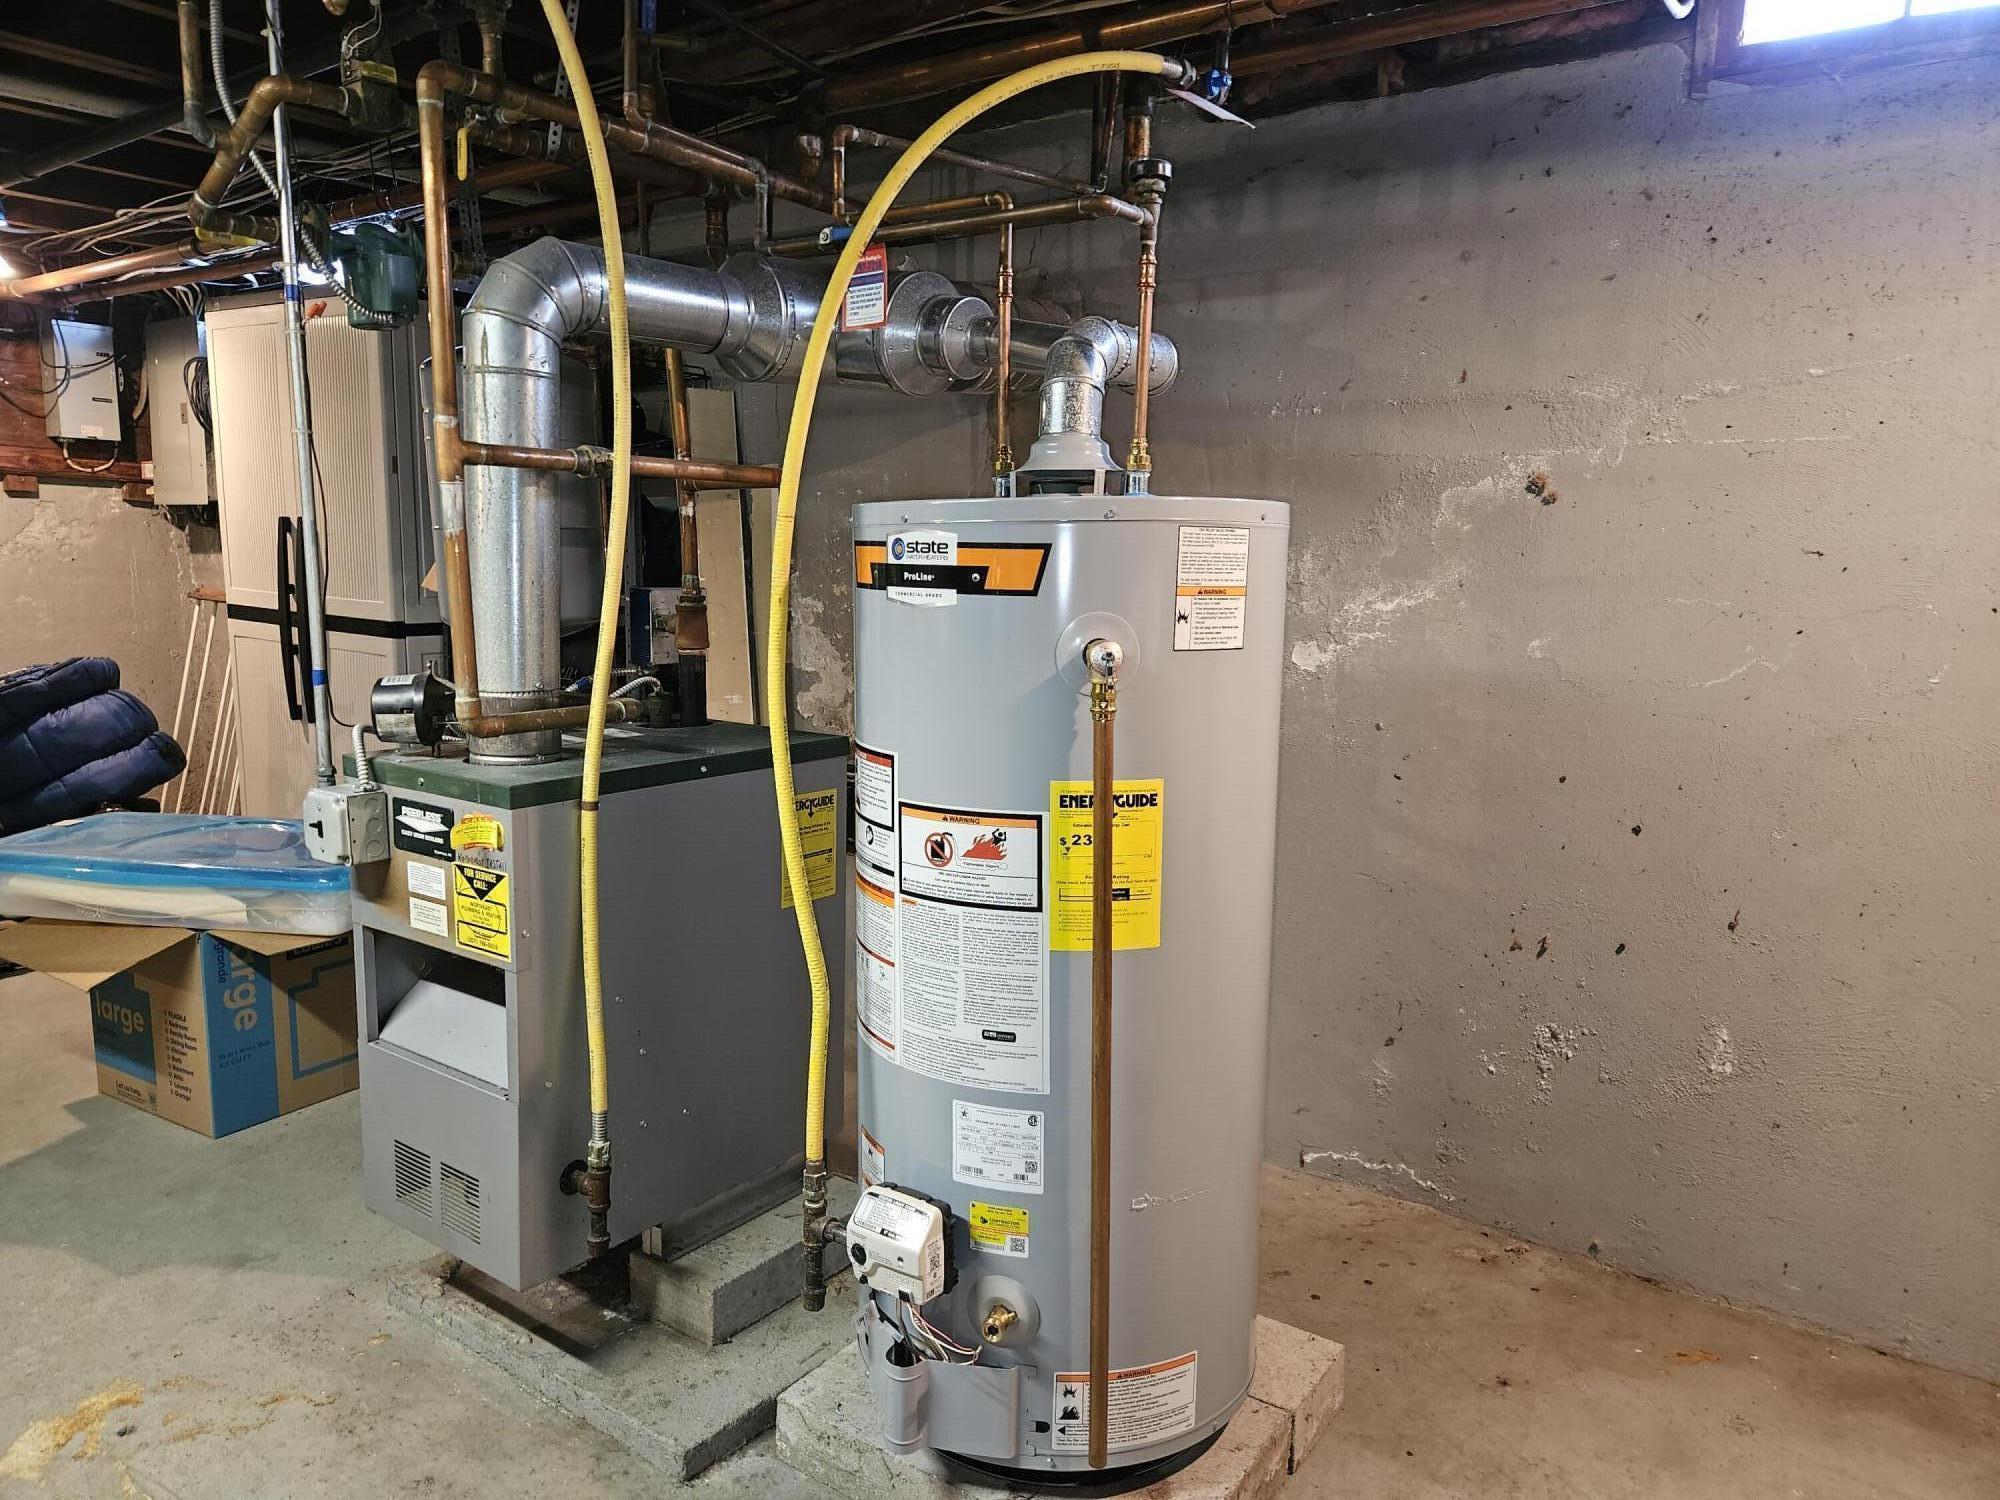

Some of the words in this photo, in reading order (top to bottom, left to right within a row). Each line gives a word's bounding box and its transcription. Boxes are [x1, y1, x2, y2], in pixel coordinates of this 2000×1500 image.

[906, 540, 949, 554] state
[401, 806, 442, 823] PEERLESS
[948, 815, 981, 825] WARNING
[96, 991, 145, 1035] large
[1123, 1367, 1152, 1379] WARNING
